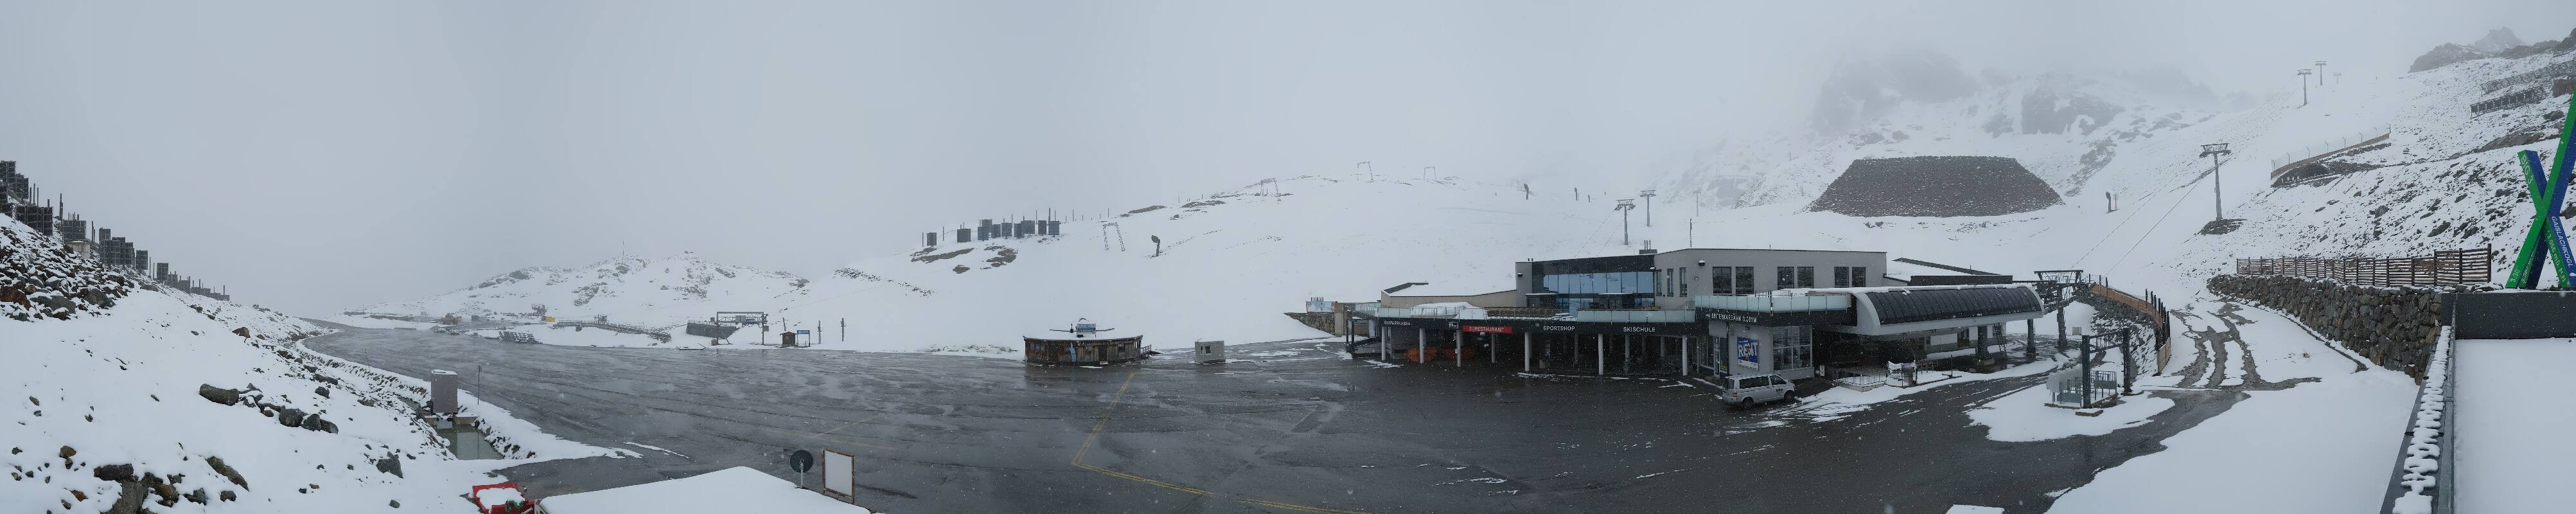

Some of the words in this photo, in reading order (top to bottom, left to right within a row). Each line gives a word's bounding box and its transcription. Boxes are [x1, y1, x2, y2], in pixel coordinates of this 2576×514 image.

[2521, 154, 2531, 176] BIG
[2527, 176, 2533, 184] 3
[2552, 216, 2573, 267] GAISLACHKOGL
[1738, 342, 1758, 358] RENT
